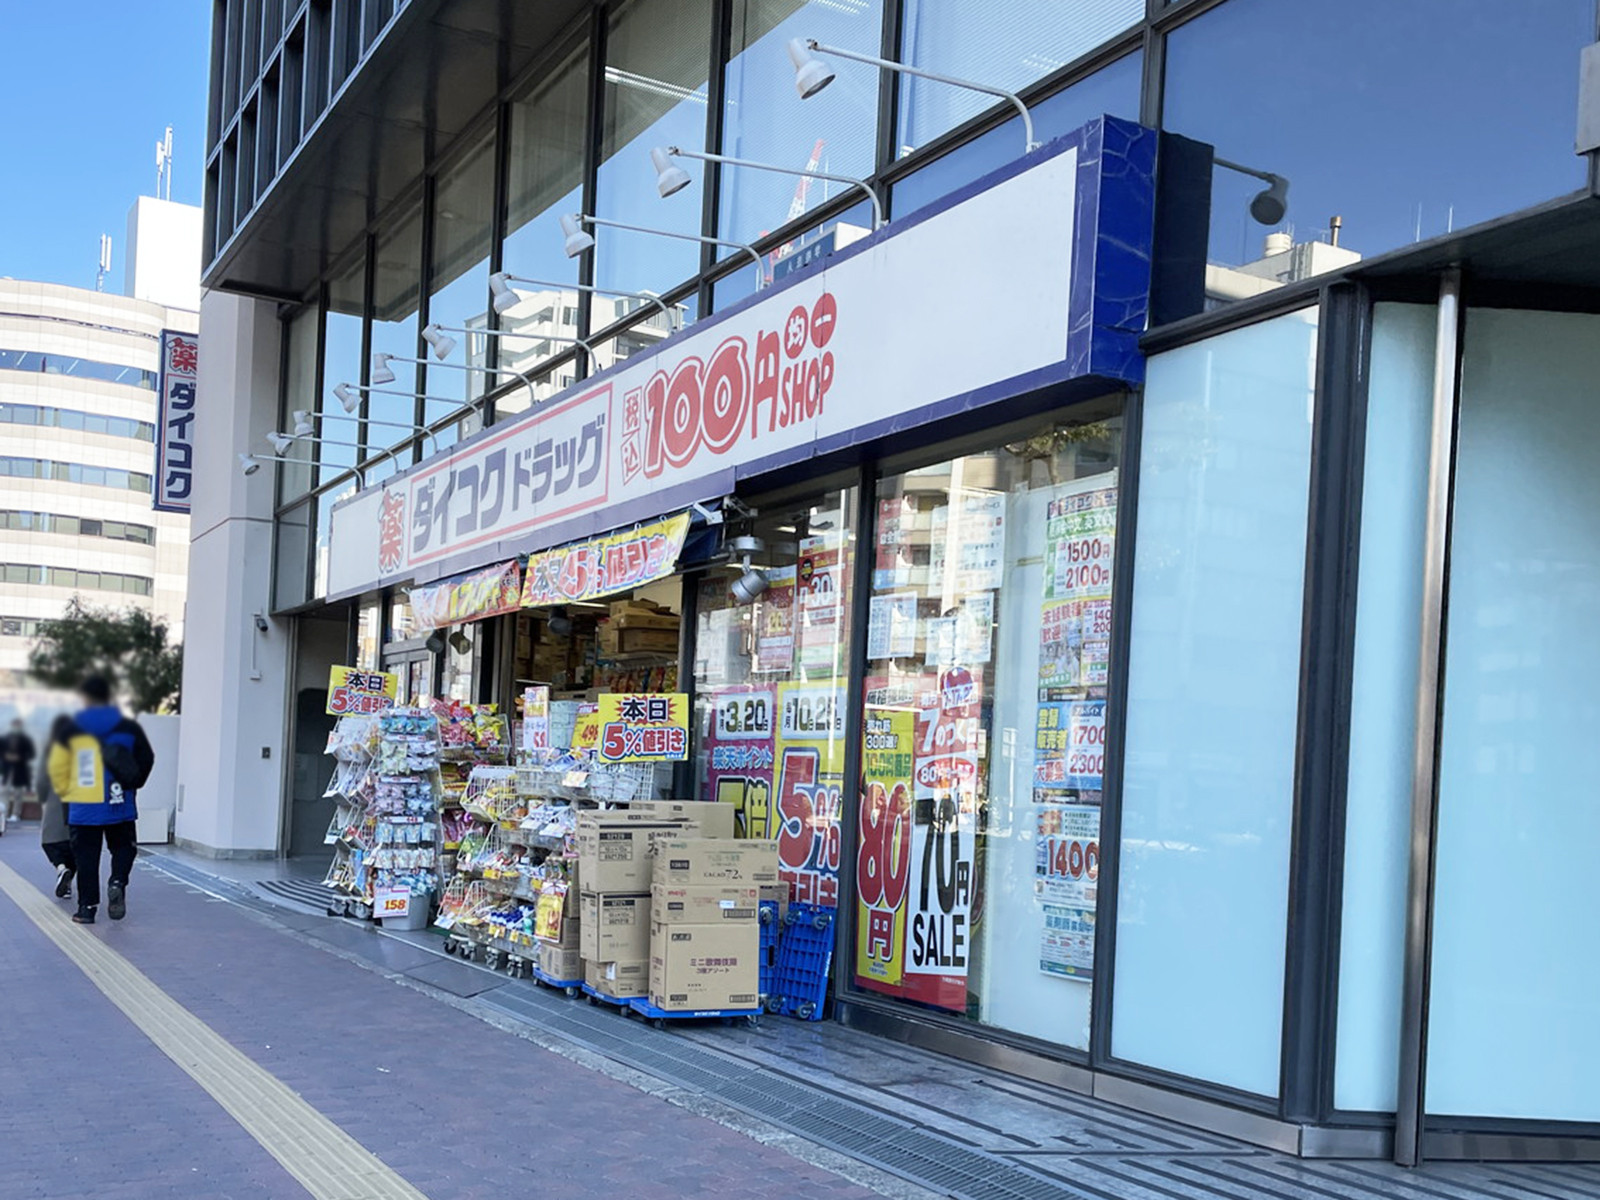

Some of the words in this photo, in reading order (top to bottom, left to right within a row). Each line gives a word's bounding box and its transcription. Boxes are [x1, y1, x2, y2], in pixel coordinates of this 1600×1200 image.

[786, 302, 835, 354] 均一
[167, 337, 198, 374] 薬
[644, 330, 780, 478] 100円
[779, 351, 834, 428] SHOP
[166, 383, 195, 499] ダイコク
[623, 391, 641, 481] 税込
[412, 413, 606, 553] ダイコクドラッグ
[378, 489, 405, 573] 薬
[1067, 539, 1110, 562] 1500円
[1066, 564, 1109, 589] 2100円
[348, 673, 382, 692] 本日
[622, 698, 667, 721] 本日
[601, 723, 685, 758] 5%値引き
[712, 745, 773, 769] 楽天ポイント
[857, 782, 911, 909] 80
[384, 899, 406, 910] 158
[868, 909, 895, 961] 円
[913, 914, 966, 967] SALE
